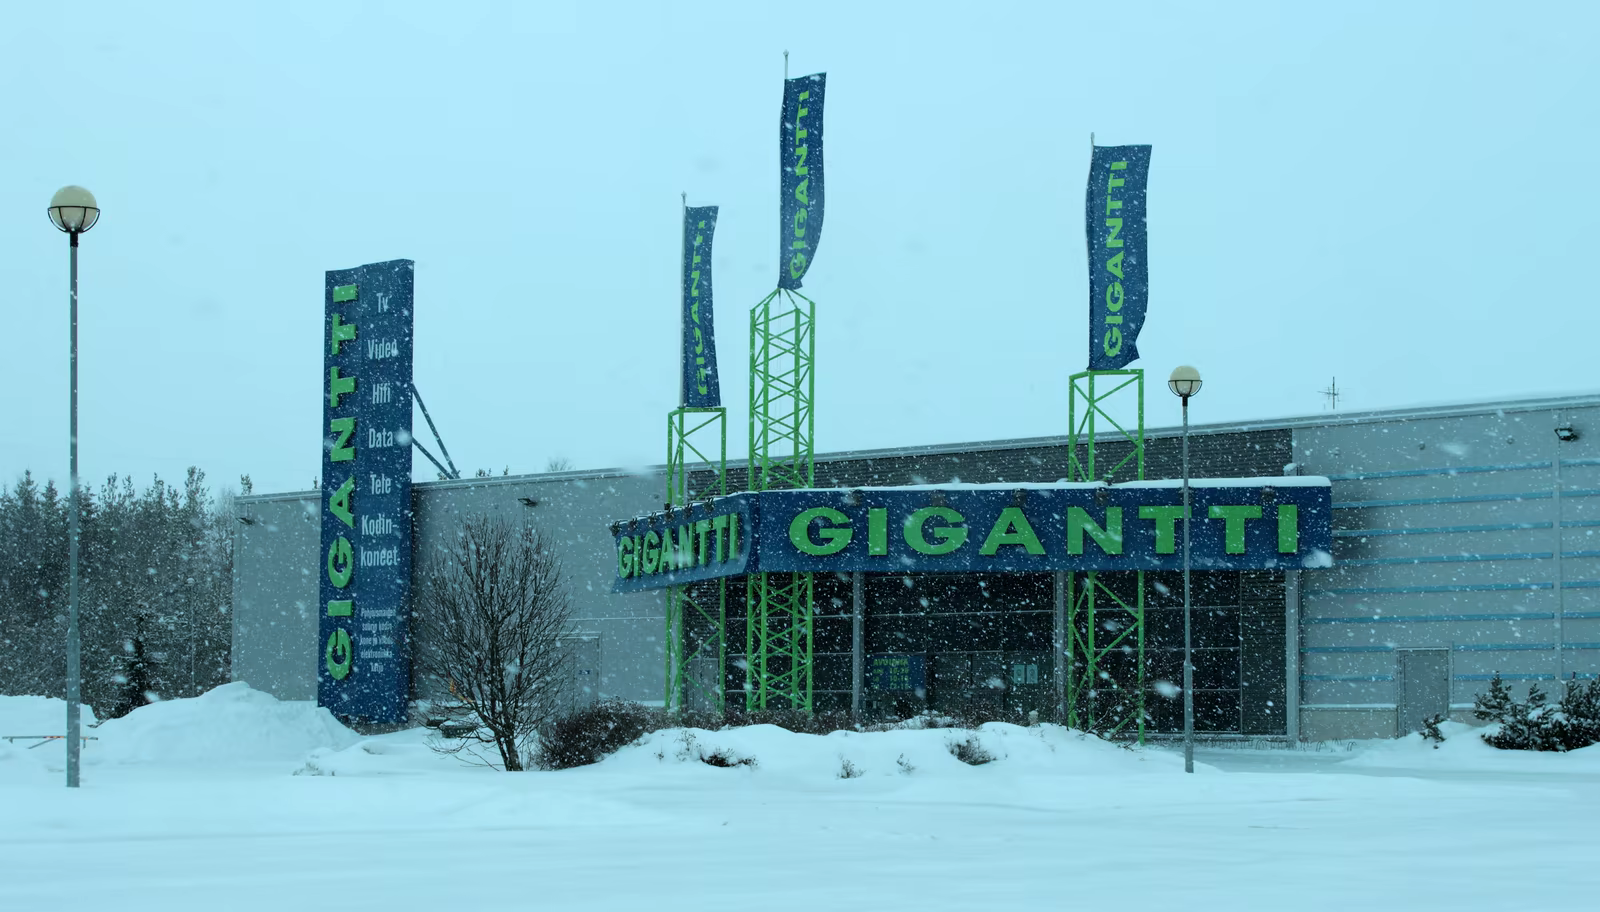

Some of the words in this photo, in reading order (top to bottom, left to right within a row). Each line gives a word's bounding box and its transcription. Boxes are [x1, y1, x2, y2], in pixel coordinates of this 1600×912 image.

[789, 90, 810, 280] GIGANTTI
[1103, 161, 1128, 357] GIGANTTI
[376, 292, 390, 313] Tv
[367, 338, 398, 360] Video
[372, 382, 391, 404] Hifi
[368, 427, 394, 449] Data
[325, 283, 358, 681] GIGANTTI
[370, 473, 392, 495] Tele
[789, 504, 1299, 557] GIGANTTI
[360, 546, 398, 567] koneet
[618, 512, 740, 579] GIGANTTI
